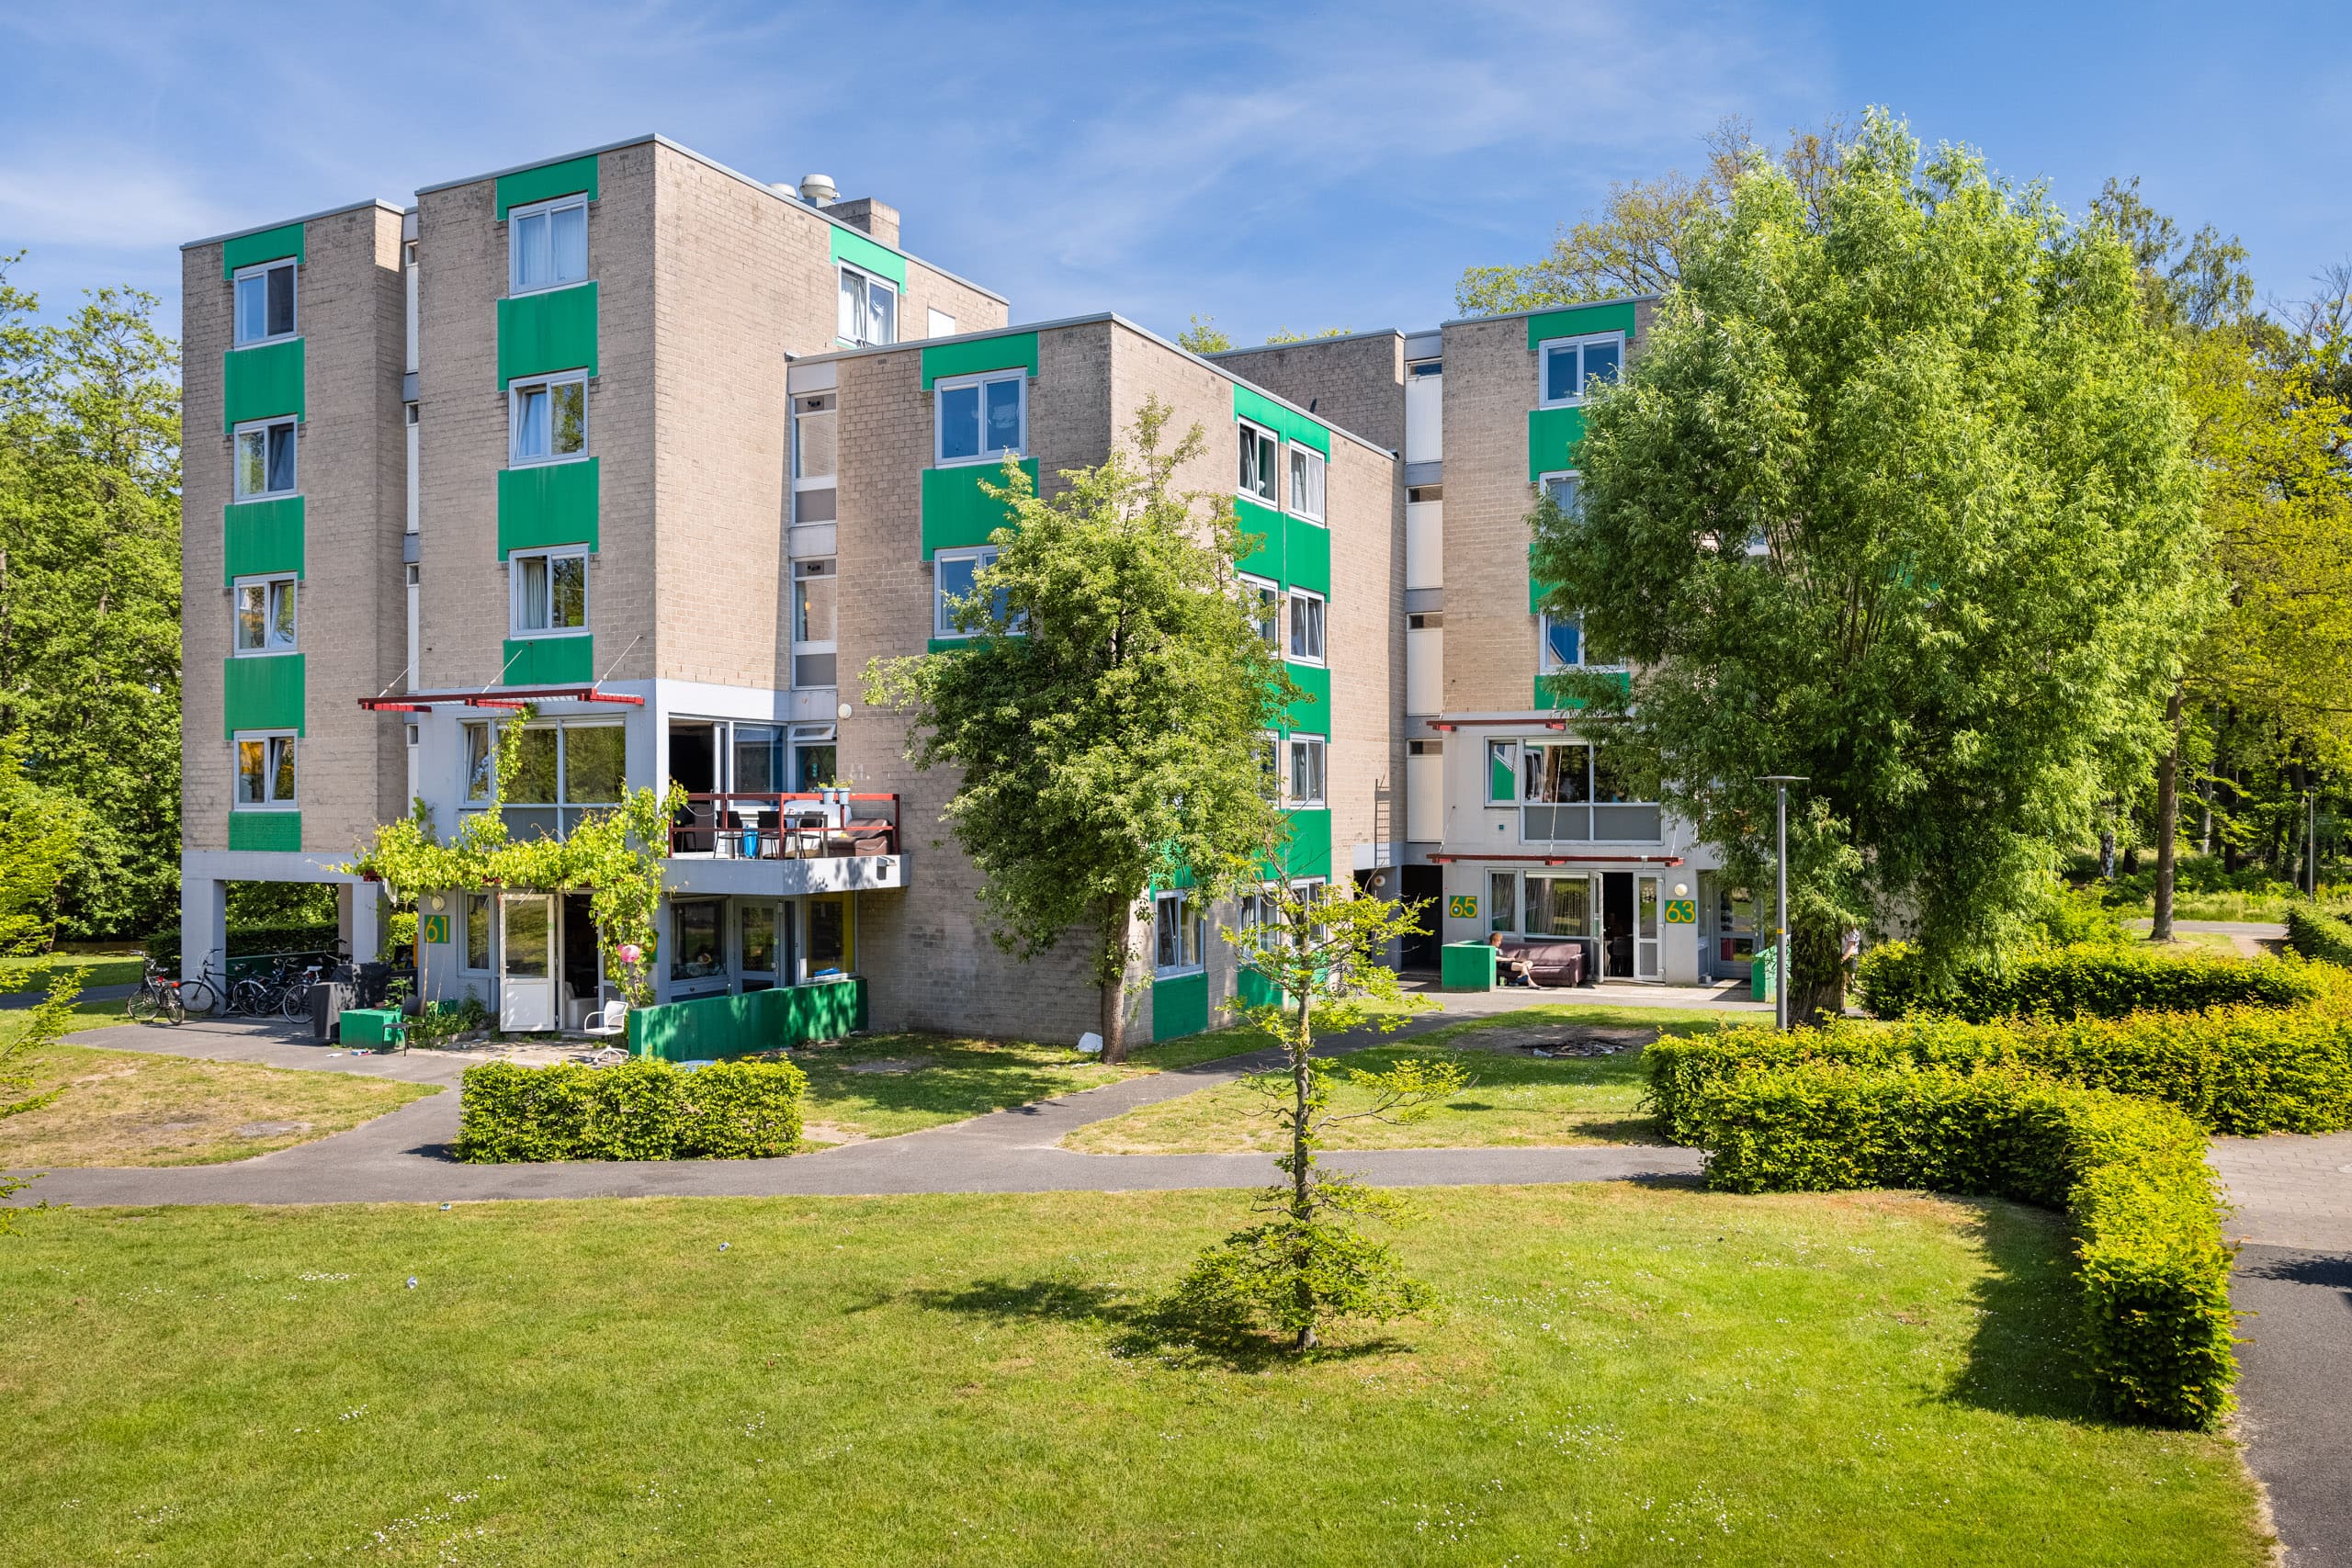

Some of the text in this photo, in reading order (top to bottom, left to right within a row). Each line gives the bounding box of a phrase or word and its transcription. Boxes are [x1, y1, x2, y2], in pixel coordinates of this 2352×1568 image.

[1450, 897, 1477, 918] 65
[1666, 901, 1695, 923] 63
[425, 916, 447, 942] 61
